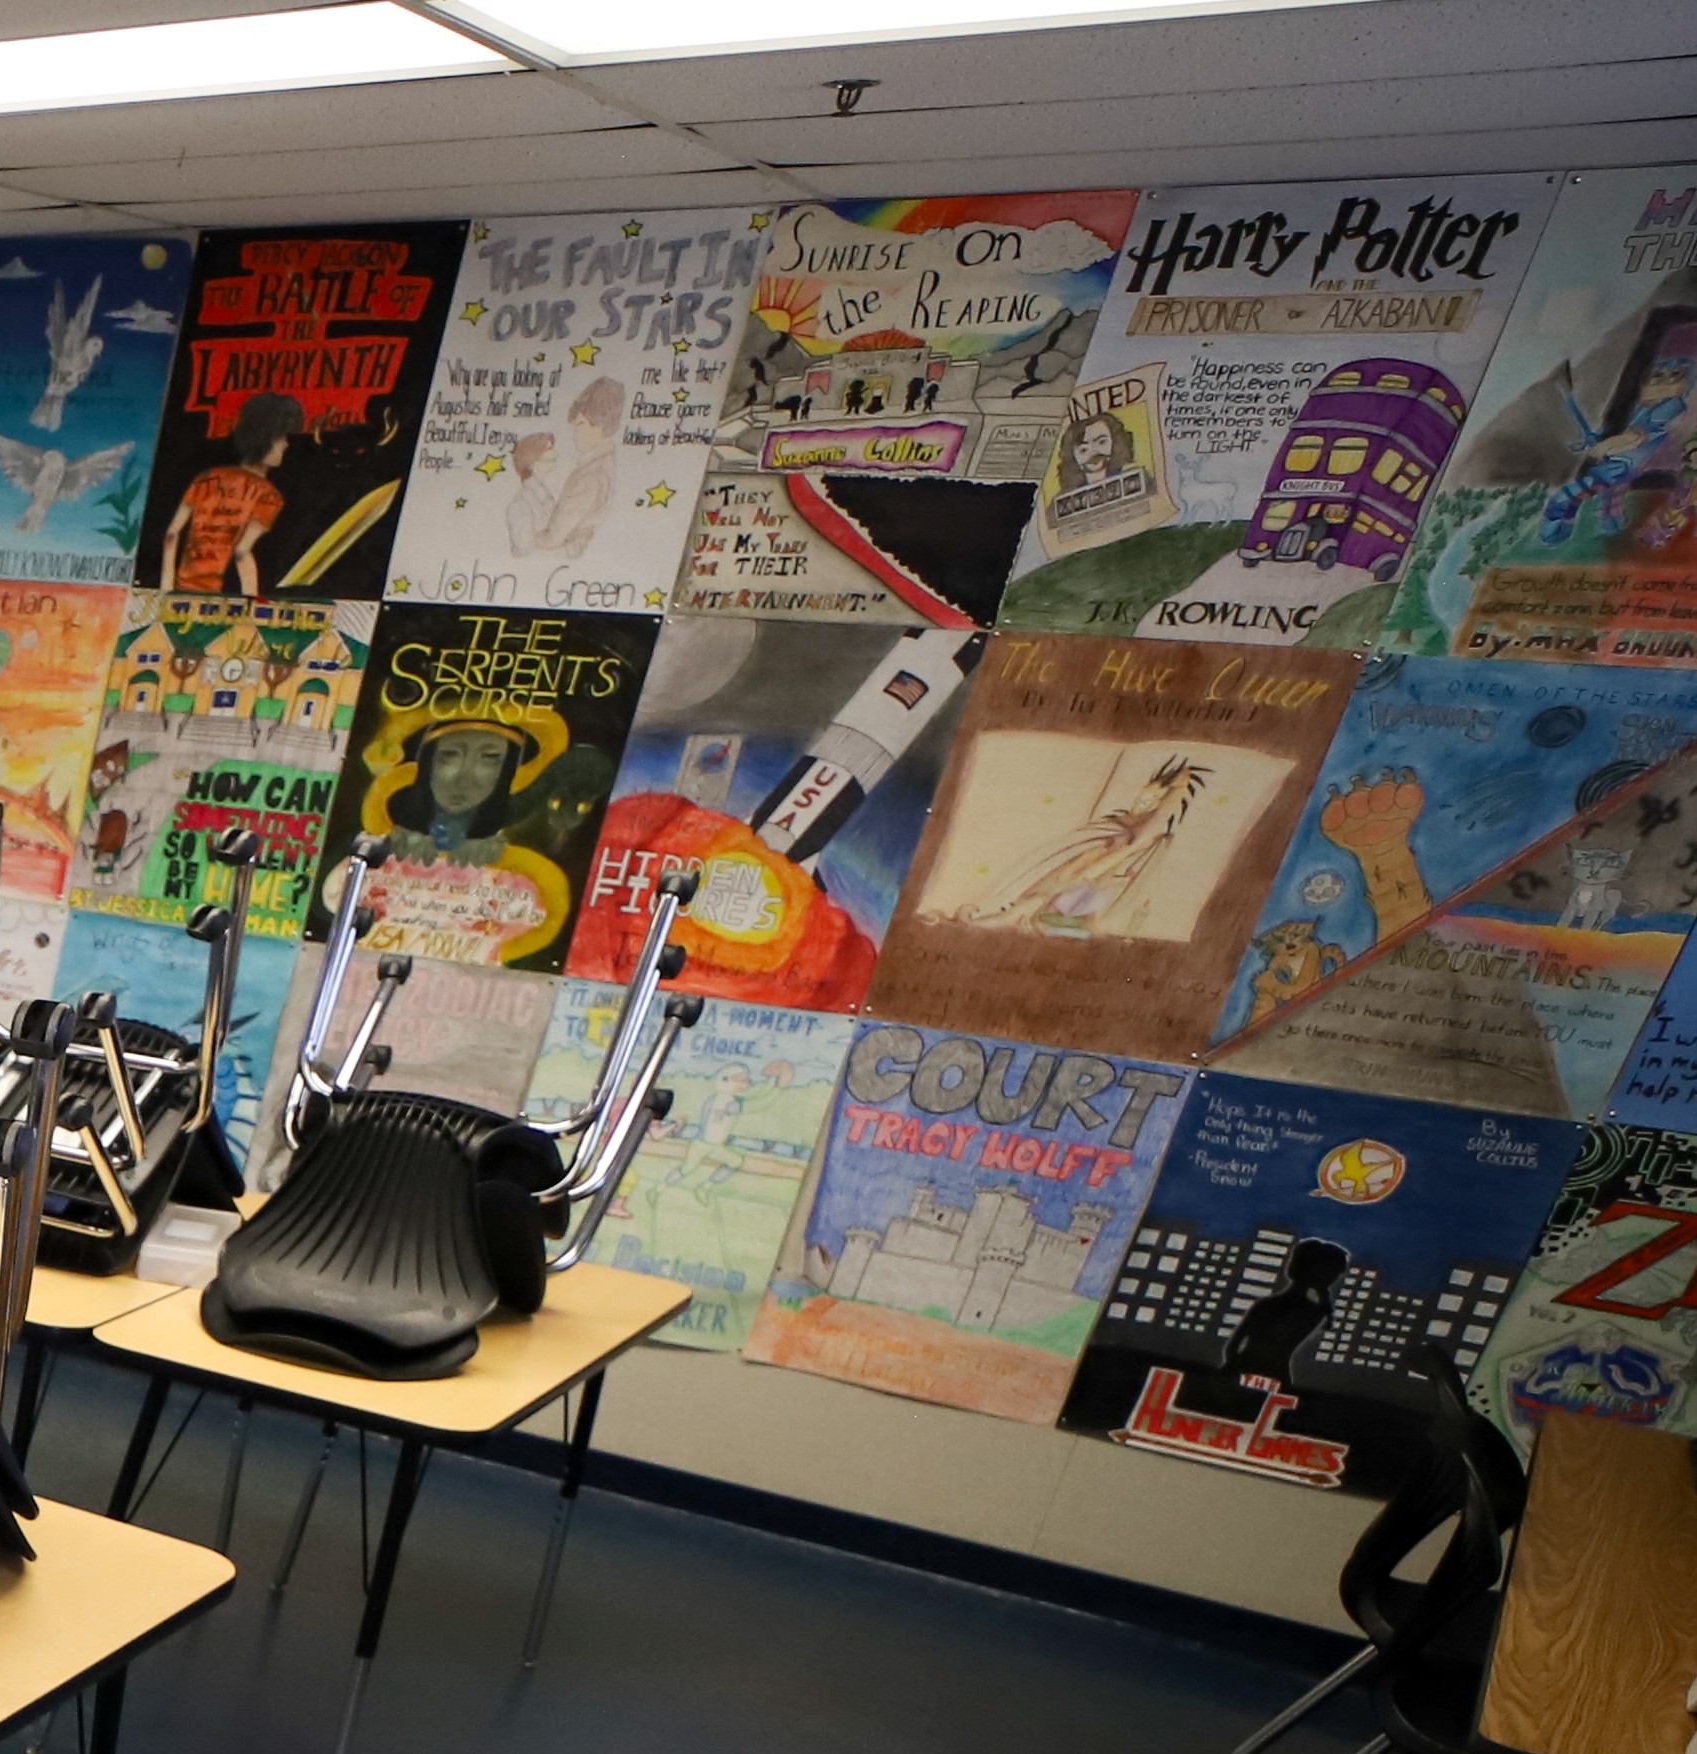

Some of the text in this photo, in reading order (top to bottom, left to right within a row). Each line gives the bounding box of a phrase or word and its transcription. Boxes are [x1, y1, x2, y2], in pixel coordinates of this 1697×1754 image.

[319, 241, 399, 267] JACKSON
[780, 211, 915, 273] SUNRISE
[1126, 194, 1520, 296] Harry Potter
[477, 229, 761, 295] THE FAULT IN
[208, 268, 422, 315] THE BATTLE OF
[1315, 279, 1380, 291] AND THE
[823, 270, 1042, 336] the REAPING
[1145, 301, 1265, 332] PRISONER
[488, 287, 734, 351] OUR STARS
[446, 358, 544, 391] Why you looking
[641, 357, 728, 385] me like that?
[1166, 374, 1312, 390] be even in
[1291, 361, 1327, 373] can
[430, 391, 552, 423] Augustus smiled
[630, 391, 673, 421] Because
[1163, 390, 1290, 403] the darkest of
[1164, 415, 1286, 428] remembers to
[1166, 403, 1299, 421] times, if one only
[1167, 428, 1261, 441] turn on the
[771, 433, 943, 468] Suzanne Collins
[1280, 479, 1319, 492] KNIGHT
[734, 556, 808, 577] THEIR
[418, 558, 636, 608] John Green
[1087, 601, 1318, 634] J.K. ROWLING
[459, 615, 568, 656] THE
[1000, 642, 1331, 710] The Hive Queen
[428, 684, 561, 725] CURSE
[1447, 678, 1620, 705] OMEN OF THE
[187, 771, 335, 814] HOW CAN
[772, 764, 840, 834] USA
[163, 831, 197, 860] SO
[165, 858, 200, 880] BE
[163, 878, 197, 901] MY
[98, 890, 186, 922] JESSICA
[1422, 930, 1569, 960] Your past the
[1389, 944, 1661, 999] MOUNTAINS. The place
[407, 965, 540, 1028] ZODIAC
[1347, 975, 1615, 1022] where was the place where
[566, 1015, 586, 1038] TO
[1277, 1022, 1425, 1053] go there once more to
[1320, 998, 1614, 1052] cats have returned before YOU must
[690, 1034, 756, 1057] CHOICE
[1638, 1049, 1663, 1070] in
[846, 1026, 1186, 1150] COURT
[1626, 1076, 1680, 1103] help
[1236, 1117, 1274, 1141] thing
[1254, 1104, 1319, 1125] It the
[843, 1103, 1133, 1187] TRACY WOLFF
[1196, 1128, 1231, 1147] than
[1465, 1136, 1541, 1156] SUZANNE
[1475, 1152, 1539, 1170] COLLINS
[1131, 1369, 1346, 1474] HUNGER GAMES
